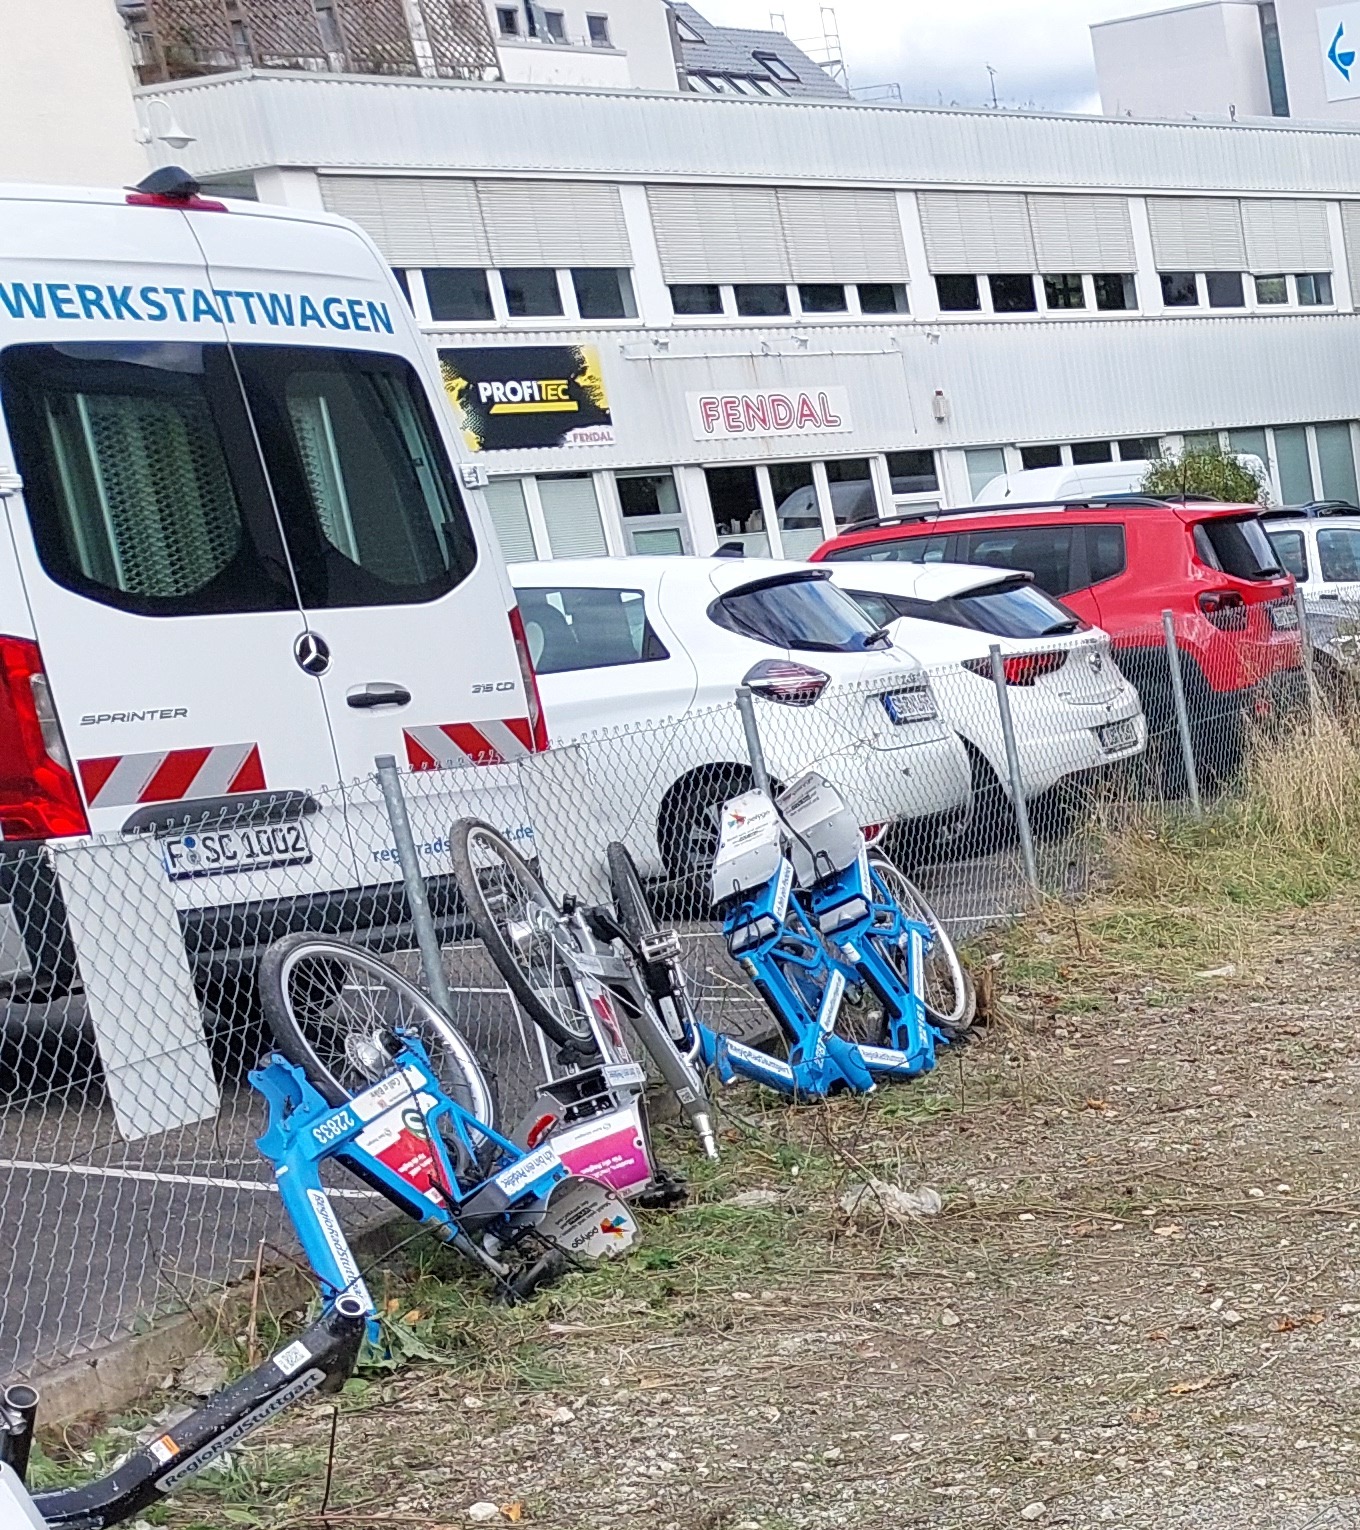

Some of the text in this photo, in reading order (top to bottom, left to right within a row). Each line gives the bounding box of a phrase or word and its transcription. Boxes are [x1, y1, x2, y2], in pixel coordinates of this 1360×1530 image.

[0, 281, 396, 335] WERKSTATTWAGEN
[478, 379, 570, 403] PROFITEC
[699, 392, 842, 434] FENDAL
[471, 681, 494, 694] 315
[79, 706, 189, 726] SPRINTER
[166, 825, 306, 868] F SC 1002
[312, 1110, 355, 1143] 22833
[571, 1224, 600, 1249] polygo
[164, 1372, 319, 1489] RegioRadStuttgart
